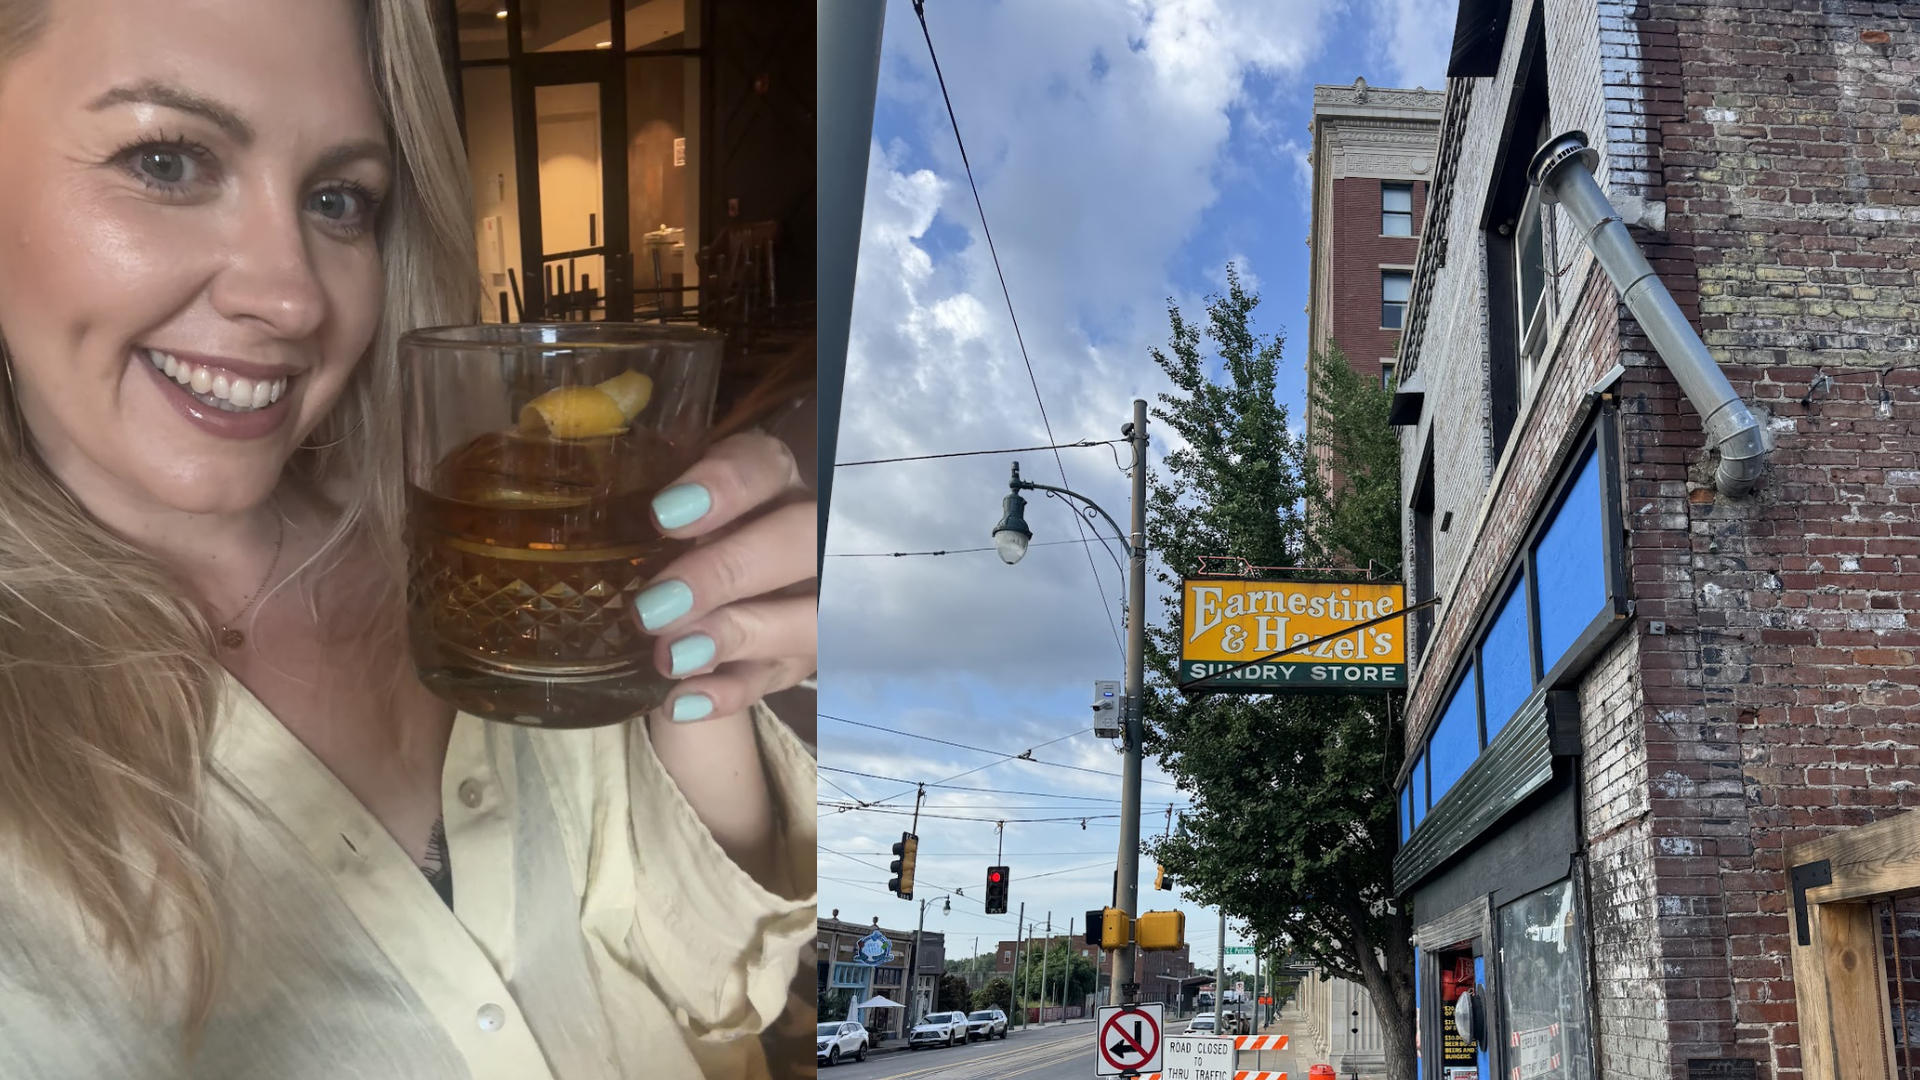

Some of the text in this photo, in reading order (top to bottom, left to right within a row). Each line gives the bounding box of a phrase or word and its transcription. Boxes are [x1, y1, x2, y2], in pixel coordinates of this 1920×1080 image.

[1189, 586, 1394, 644] Earnestine
[1220, 616, 1393, 660] & Hazel's
[1189, 663, 1396, 681] SUNDRY STORE
[1170, 1041, 1228, 1055] ROAD CLOSED
[1194, 1056, 1203, 1066] TO
[1168, 1067, 1227, 1080] THRU TRAFFIC
